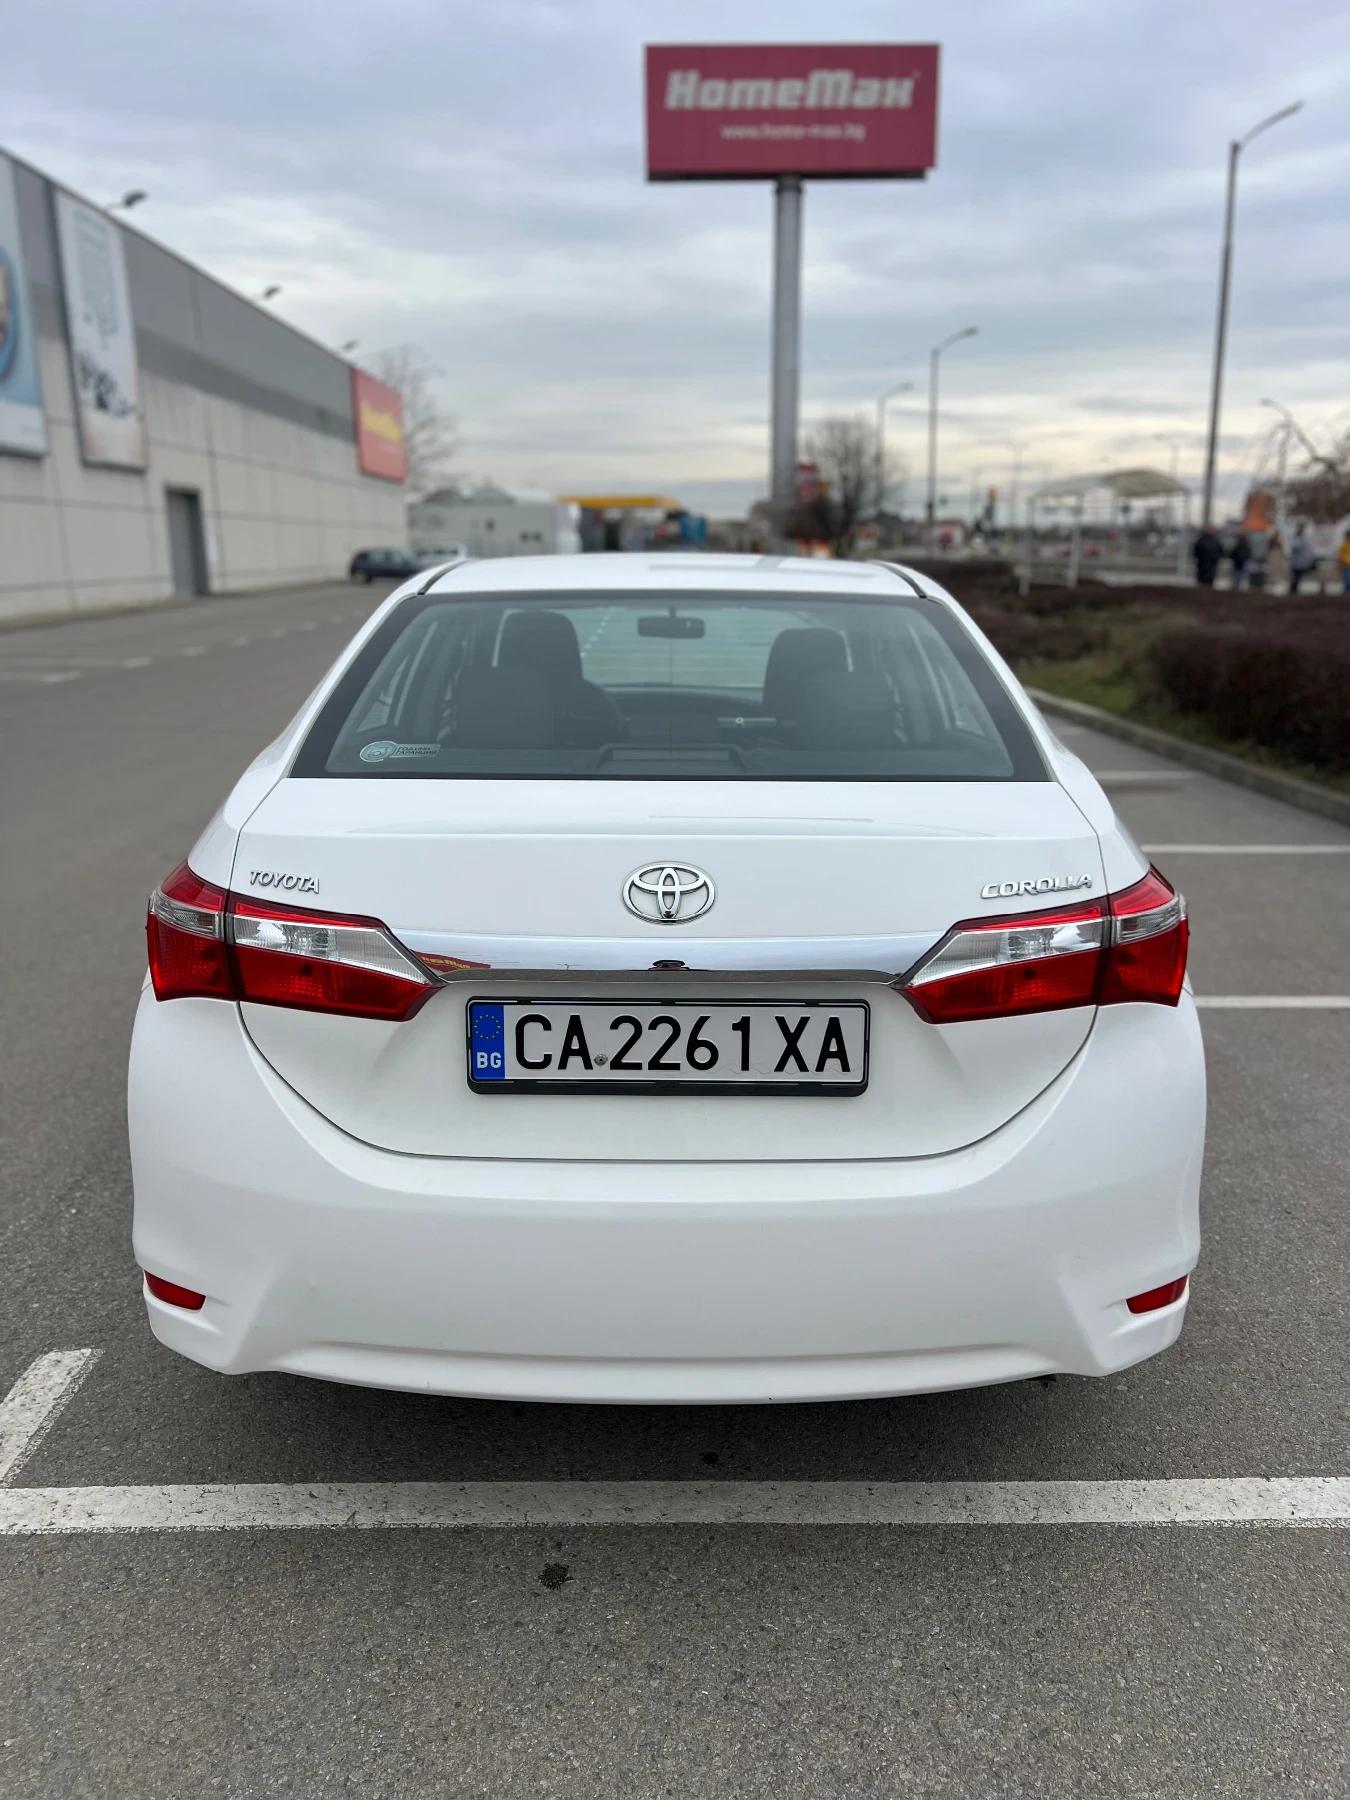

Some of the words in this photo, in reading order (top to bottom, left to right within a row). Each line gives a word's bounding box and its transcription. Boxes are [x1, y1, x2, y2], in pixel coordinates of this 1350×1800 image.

[665, 69, 914, 110] HomeMax
[250, 871, 319, 894] TOYOTA
[980, 873, 1093, 899] COROLLA
[476, 1052, 502, 1069] BG
